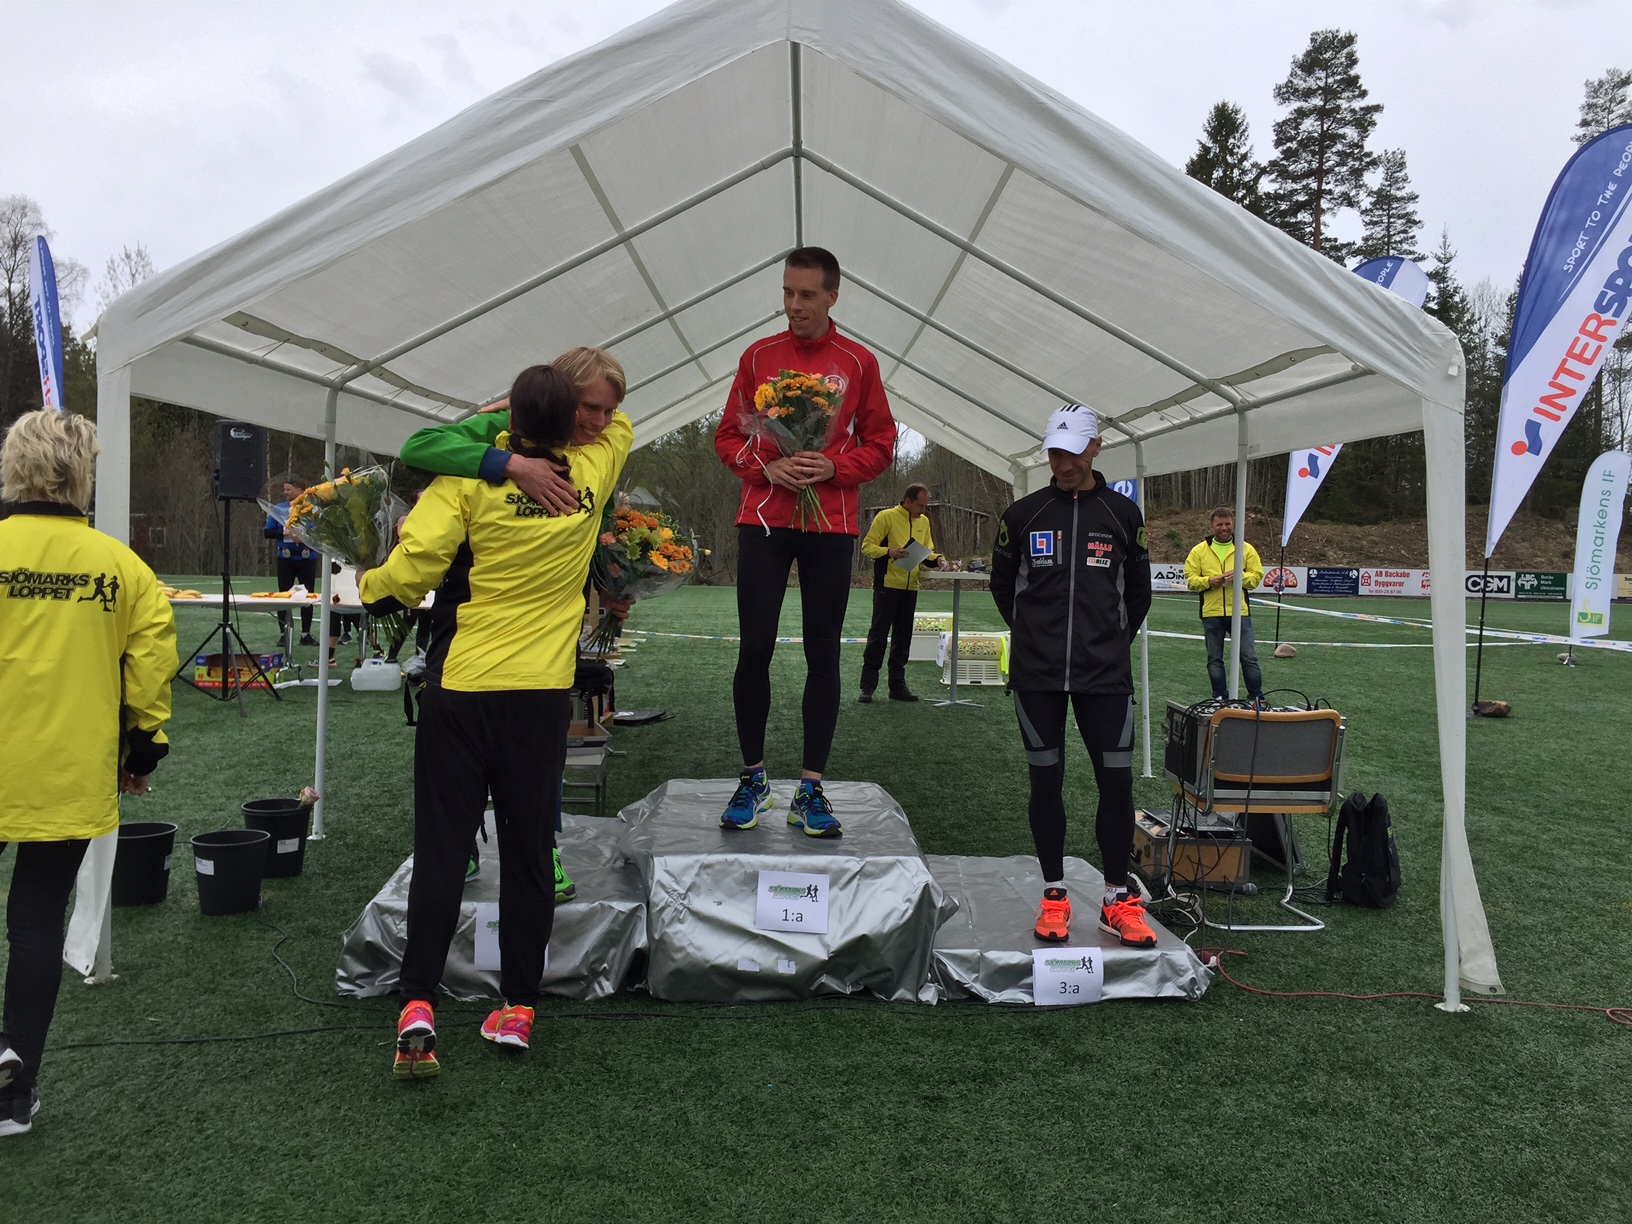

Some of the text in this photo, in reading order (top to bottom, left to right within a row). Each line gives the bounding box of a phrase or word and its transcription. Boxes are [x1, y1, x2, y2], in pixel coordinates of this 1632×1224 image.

[1563, 231, 1589, 273] SPORT
[1585, 210, 1601, 228] TO
[1597, 181, 1617, 207] THE
[1533, 235, 1632, 422] INTERSPO
[1585, 469, 1616, 591] Sjömarkens IF
[0, 567, 91, 588] SJÖMARKS
[1374, 570, 1383, 578] AB
[1467, 576, 1510, 592] CGM
[7, 585, 76, 601] LOPPET
[781, 909, 804, 923] 1:a
[1059, 981, 1080, 995] 3:a
